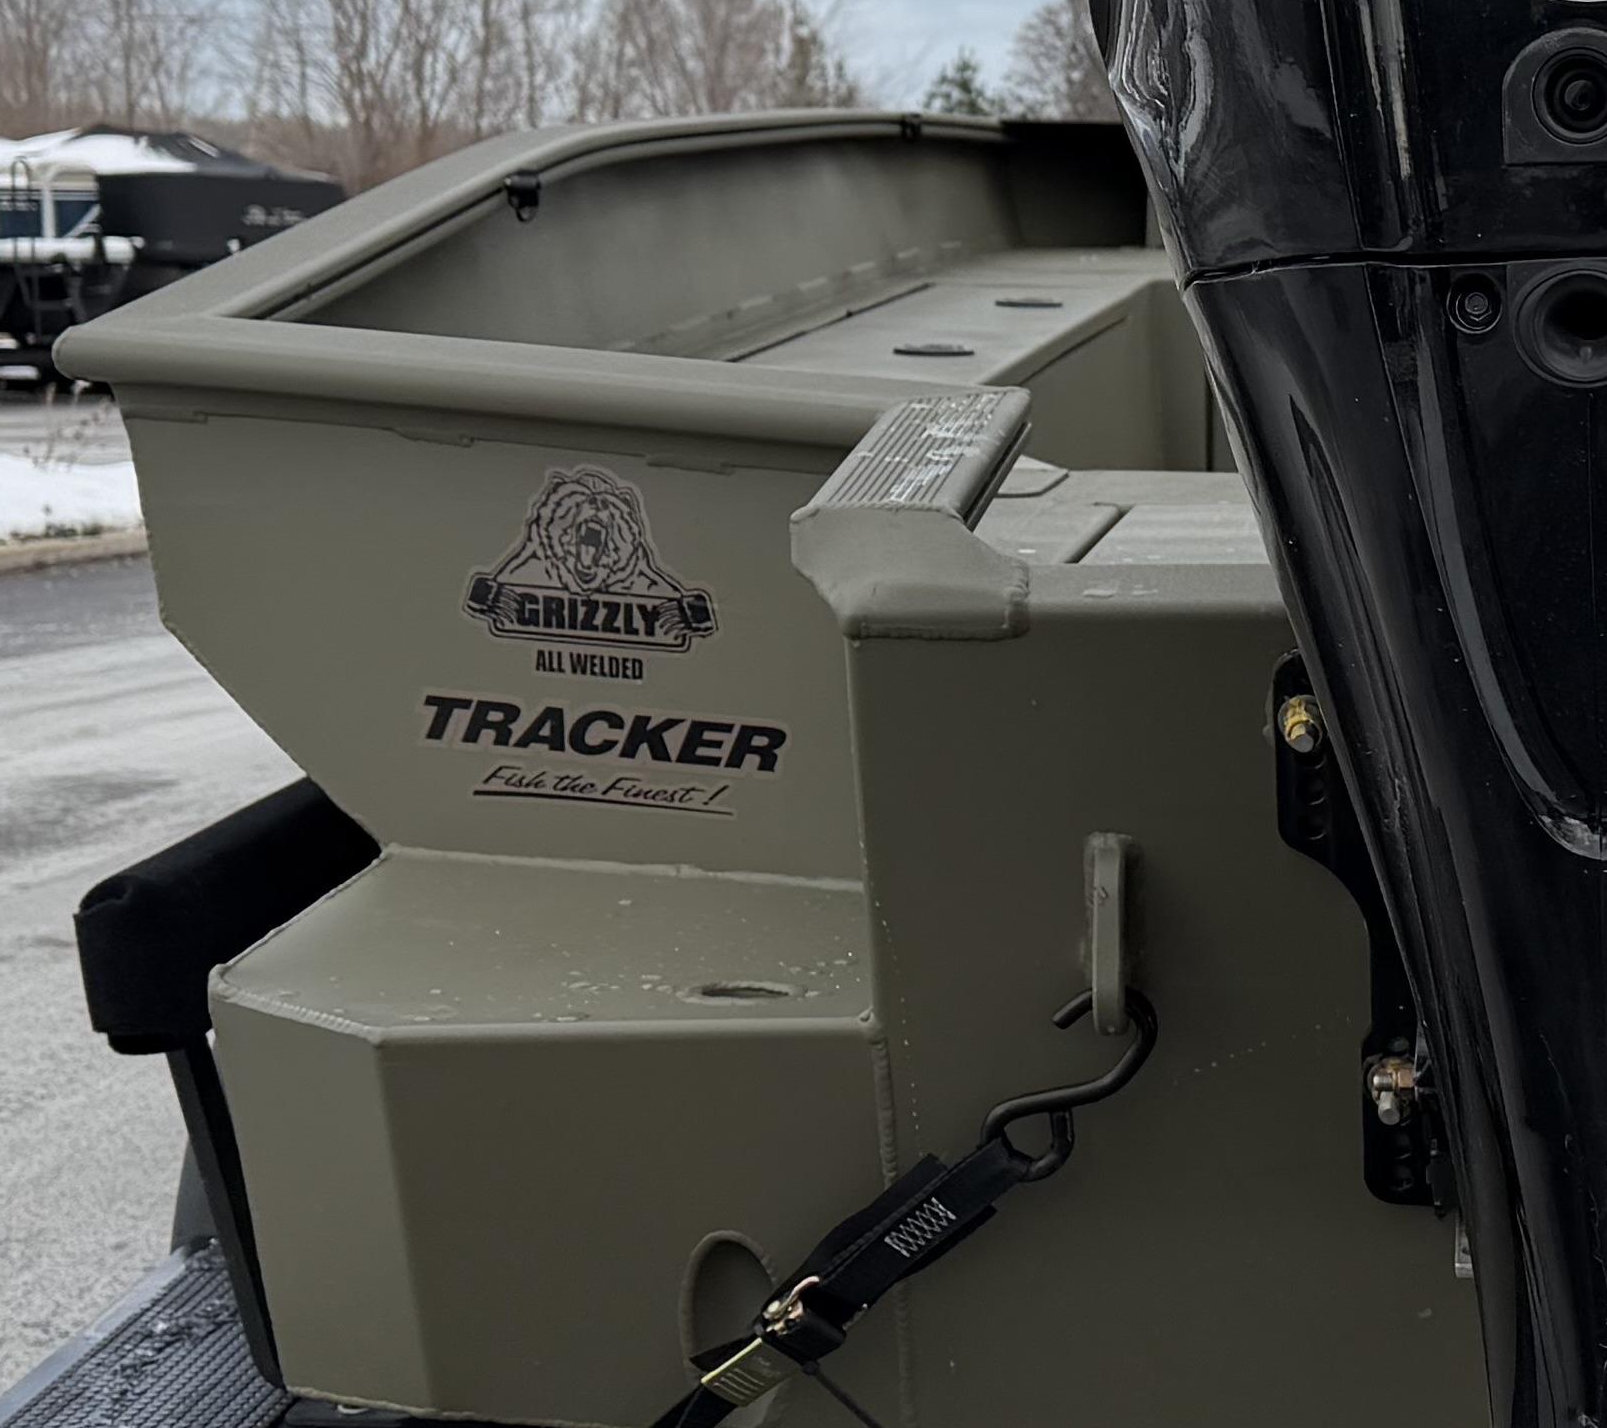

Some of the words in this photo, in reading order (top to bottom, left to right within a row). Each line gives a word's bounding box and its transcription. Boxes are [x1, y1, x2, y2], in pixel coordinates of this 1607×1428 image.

[516, 592, 661, 637] GRIZZLY
[535, 649, 566, 674] ALL
[569, 651, 644, 680] WELDED
[423, 694, 788, 773] TRACKER
[482, 764, 547, 791] Fish
[553, 773, 597, 795] the
